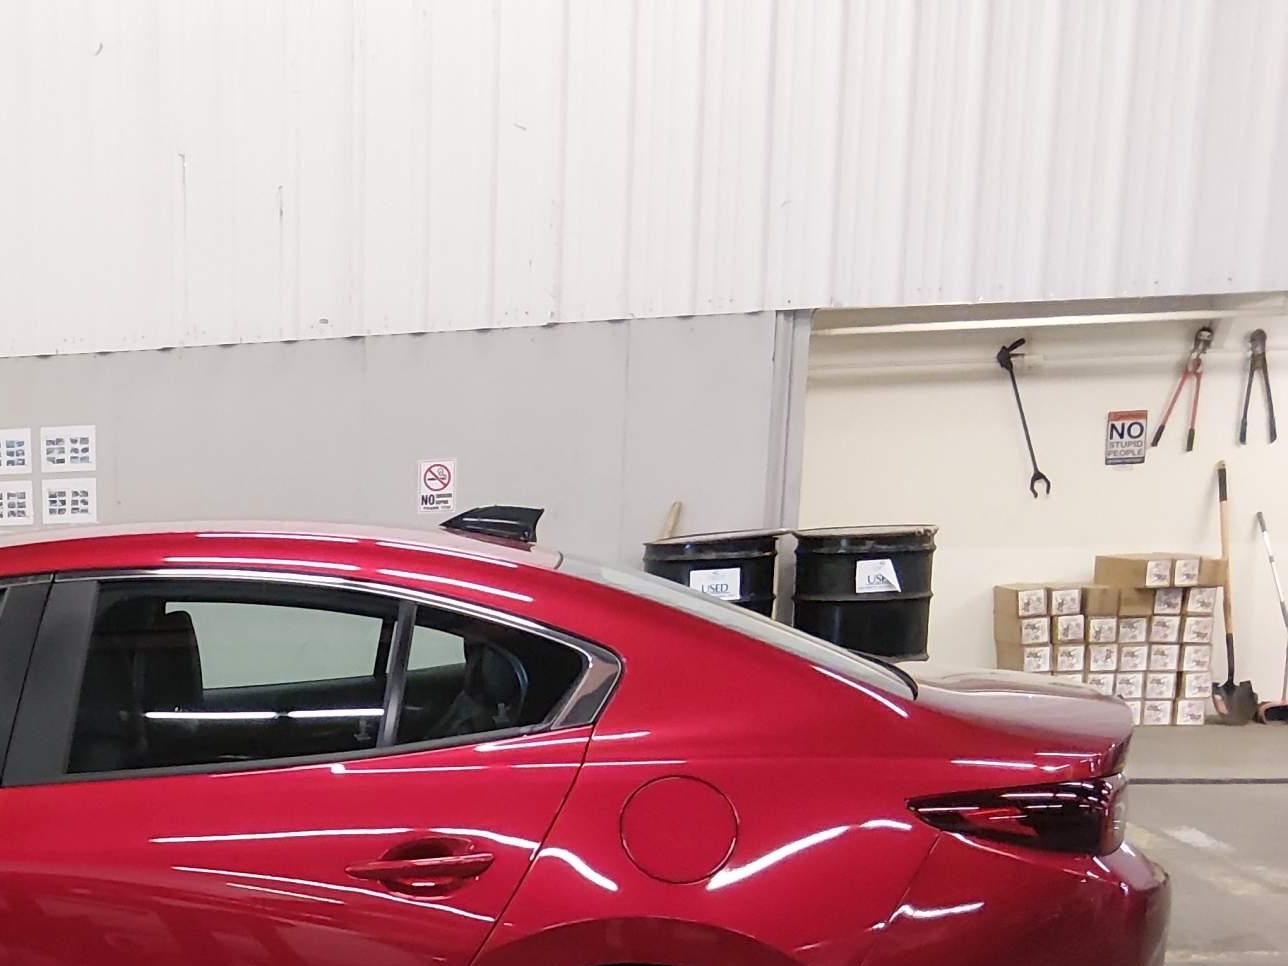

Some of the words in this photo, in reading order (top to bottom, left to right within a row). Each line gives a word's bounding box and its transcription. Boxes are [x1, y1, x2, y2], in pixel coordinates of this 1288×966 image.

[1110, 422, 1144, 440] NO
[421, 494, 435, 505] NO
[702, 583, 729, 593] USED
